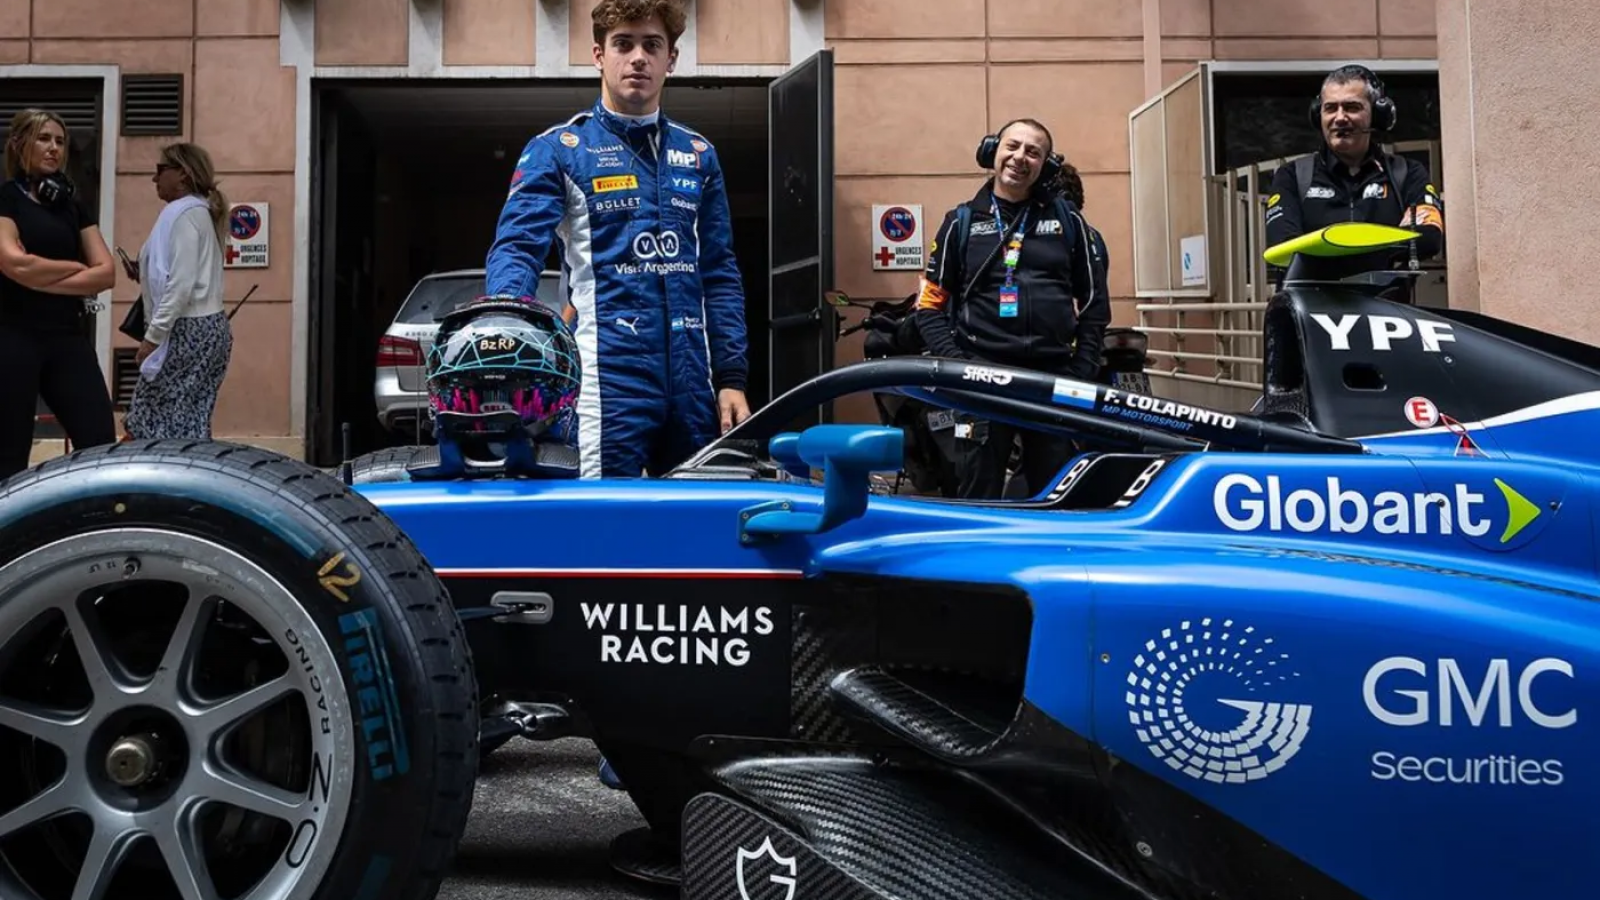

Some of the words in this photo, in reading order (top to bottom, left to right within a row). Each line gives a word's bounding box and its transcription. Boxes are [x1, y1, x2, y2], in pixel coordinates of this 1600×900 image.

[672, 177, 698, 190] YPF
[1035, 220, 1062, 234] MP
[240, 244, 266, 253] URGENCES
[895, 247, 921, 255] URGENCES
[1310, 313, 1457, 352] YPF
[1101, 404, 1118, 415] MP
[1120, 408, 1194, 431] MOTORSPORT
[1103, 387, 1121, 404] F.
[1126, 393, 1237, 430] COLAPINTO
[1411, 400, 1432, 424] E
[1213, 473, 1491, 537] Globant
[580, 602, 775, 635] WILLIAMS
[601, 635, 751, 666] RACING
[285, 628, 331, 735] RACING
[1362, 656, 1578, 729] GMC
[1371, 751, 1564, 785] Securities
